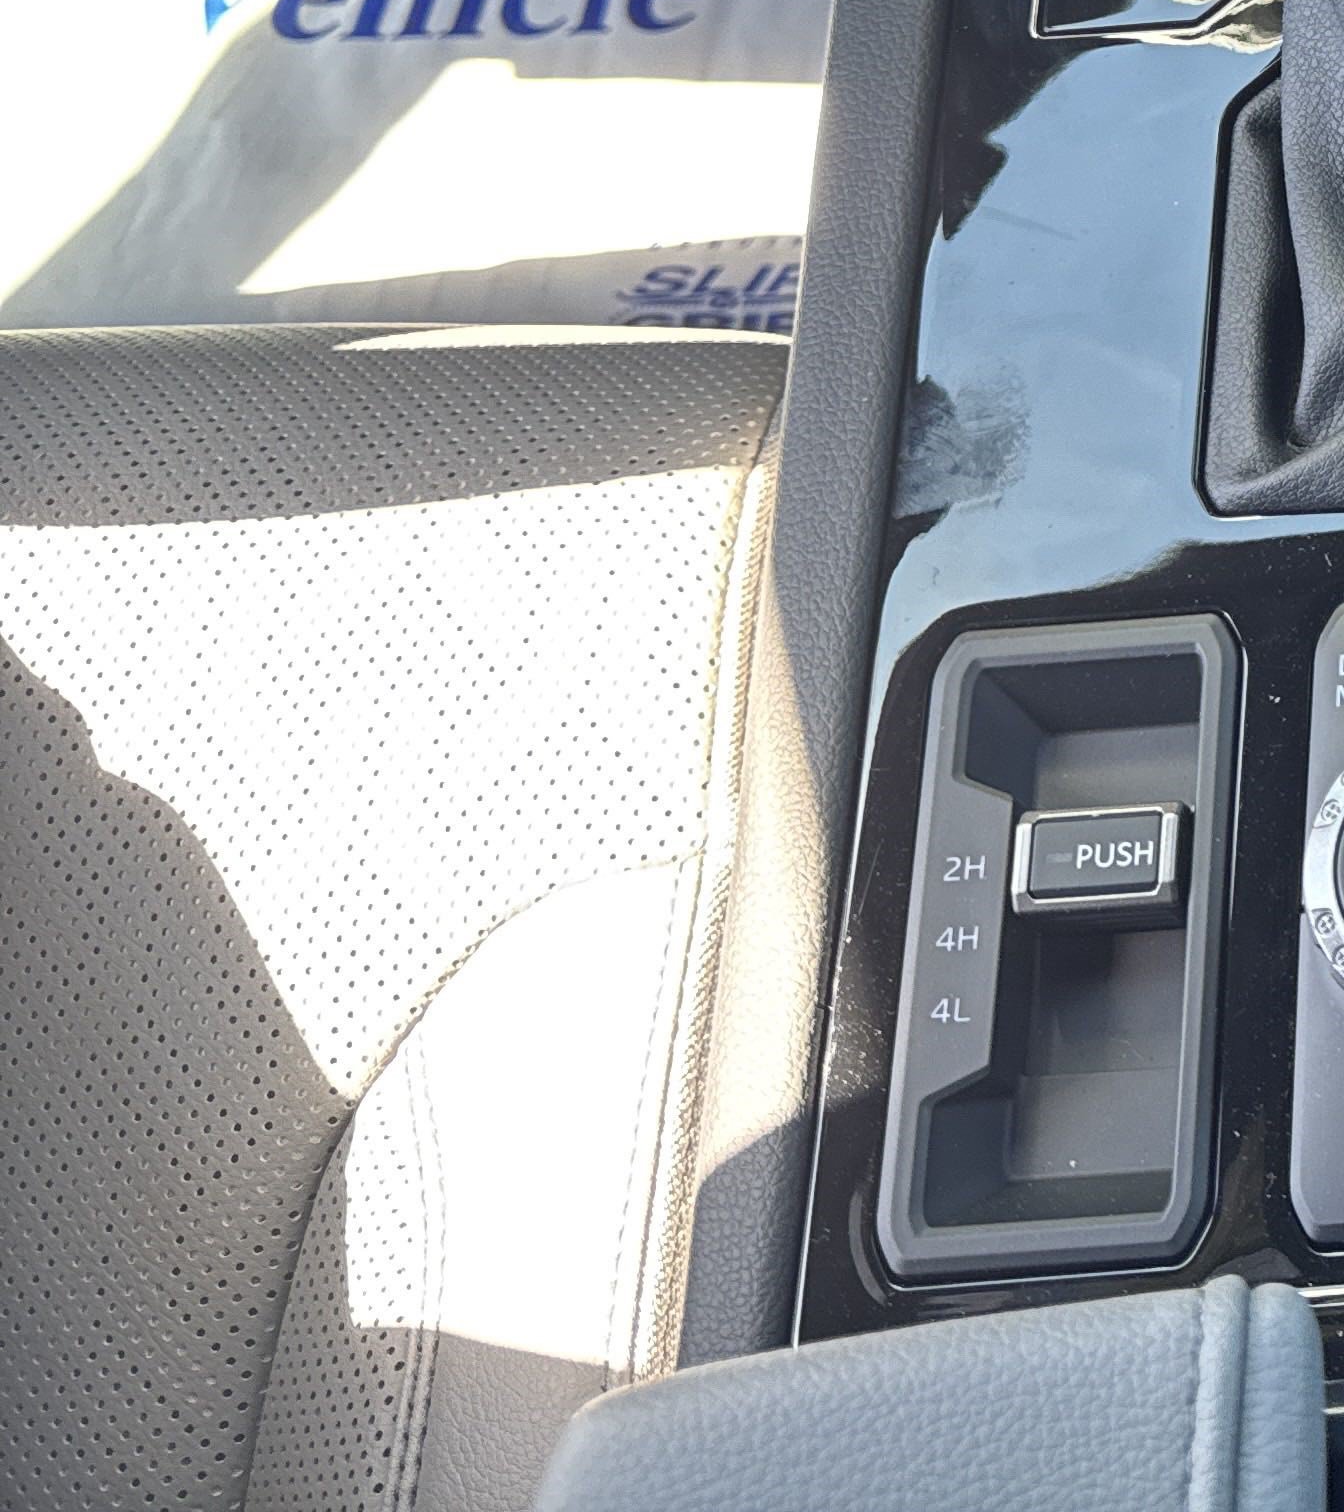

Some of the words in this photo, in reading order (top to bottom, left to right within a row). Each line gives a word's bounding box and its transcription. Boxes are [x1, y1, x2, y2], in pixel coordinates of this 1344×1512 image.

[1076, 840, 1155, 869] PUSH
[943, 855, 986, 882] 2H
[936, 925, 979, 952] 4H
[931, 997, 971, 1024] 4L
